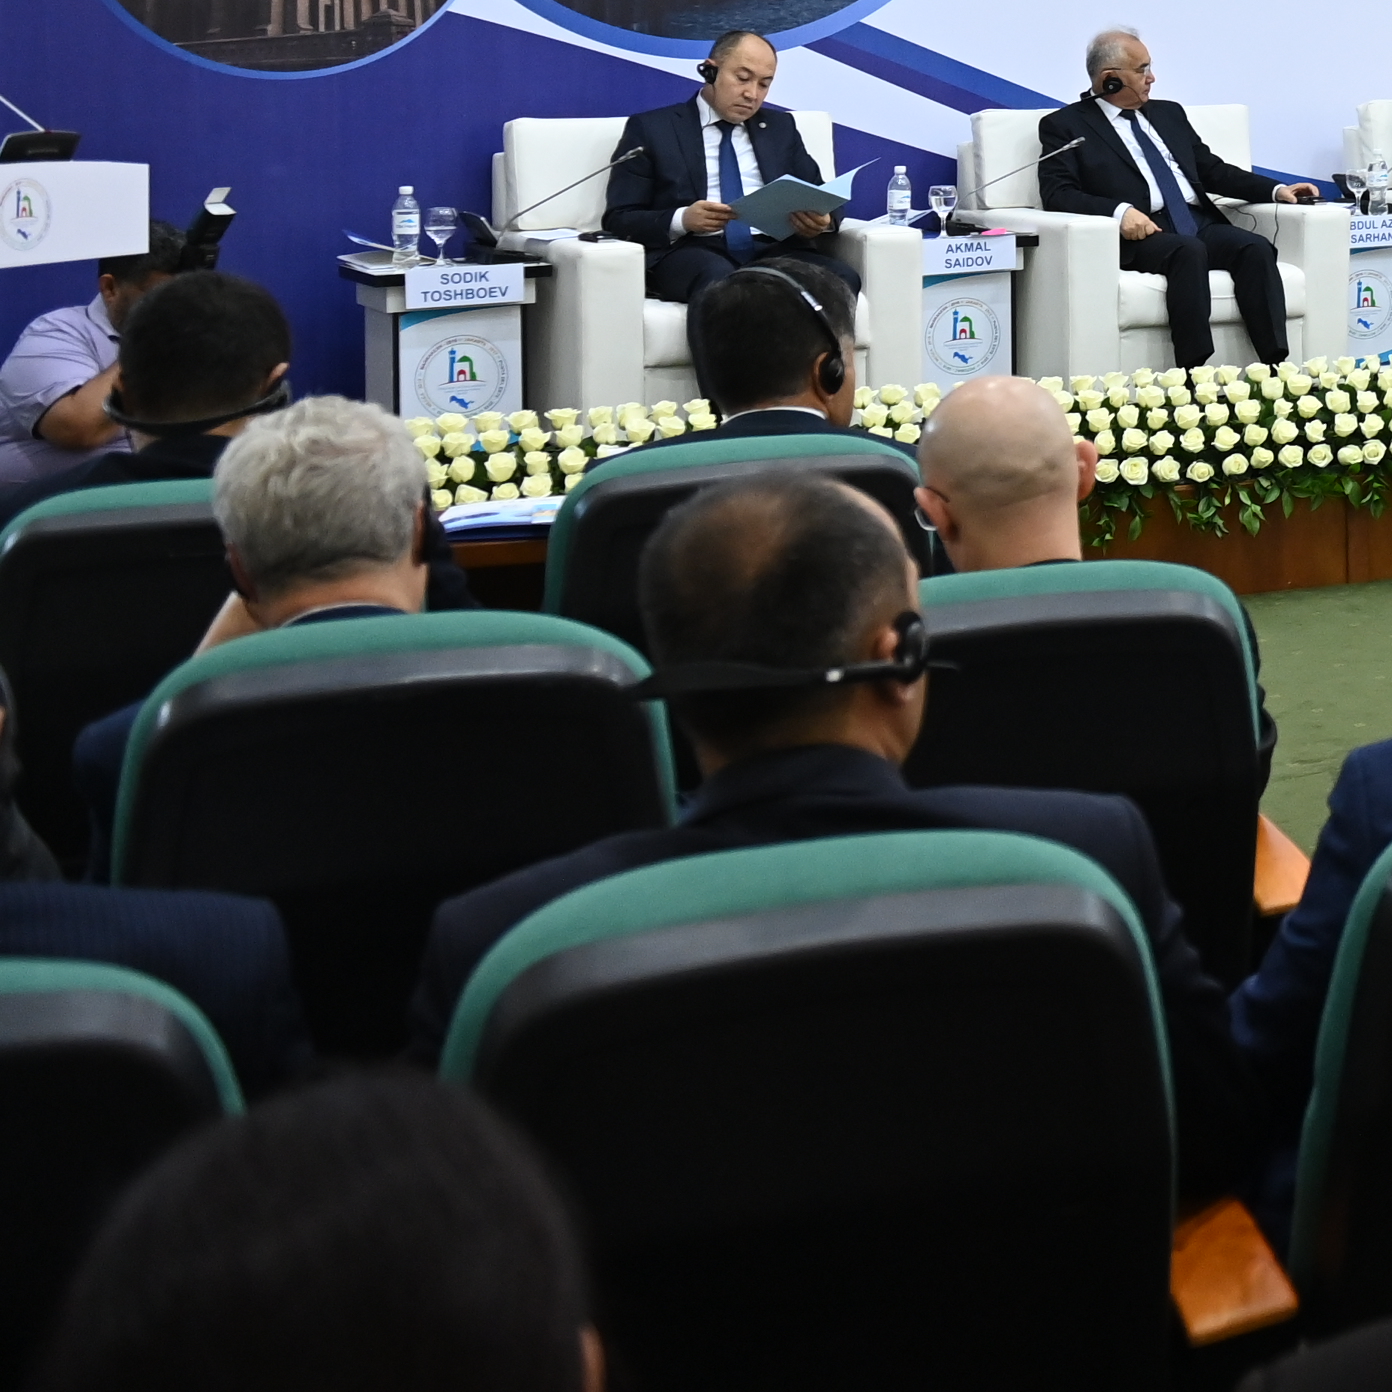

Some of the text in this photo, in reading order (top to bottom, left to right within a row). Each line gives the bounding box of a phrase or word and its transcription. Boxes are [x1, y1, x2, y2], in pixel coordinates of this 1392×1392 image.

[1350, 220, 1378, 231] BDUL
[946, 241, 991, 254] AKMAL
[944, 255, 993, 269] SAIDOV
[440, 271, 490, 285] SODIK
[421, 286, 509, 302] TOSHBOEV
